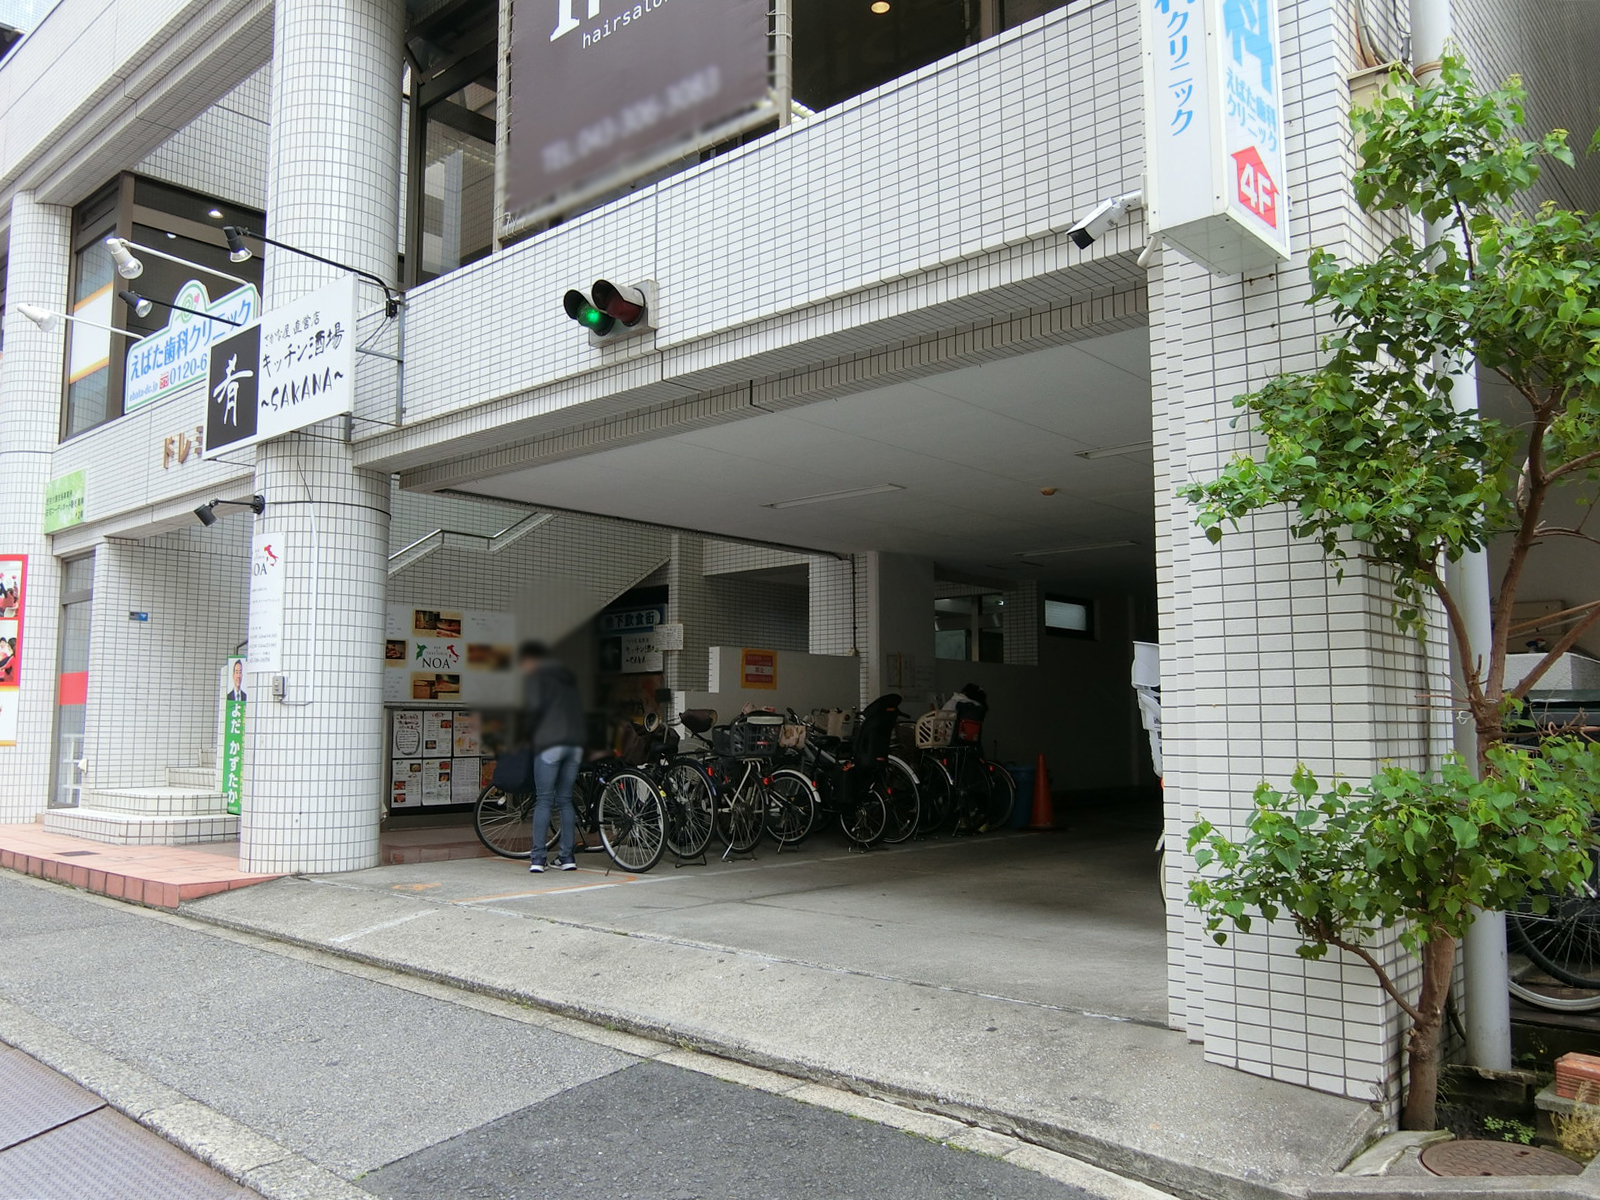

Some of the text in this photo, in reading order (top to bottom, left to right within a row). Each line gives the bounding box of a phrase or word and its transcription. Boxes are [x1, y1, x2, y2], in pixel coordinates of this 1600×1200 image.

[582, 0, 668, 49] hairsalo
[1154, 0, 1195, 137] クリニック
[1227, 94, 1277, 152] クリニック
[1240, 162, 1272, 216] 4F
[130, 299, 251, 382] えばた歯科クリニック
[262, 321, 345, 378] キッチン酒場
[422, 657, 451, 669] NOA
[230, 703, 241, 734] よだ
[227, 740, 240, 804] かずたか
